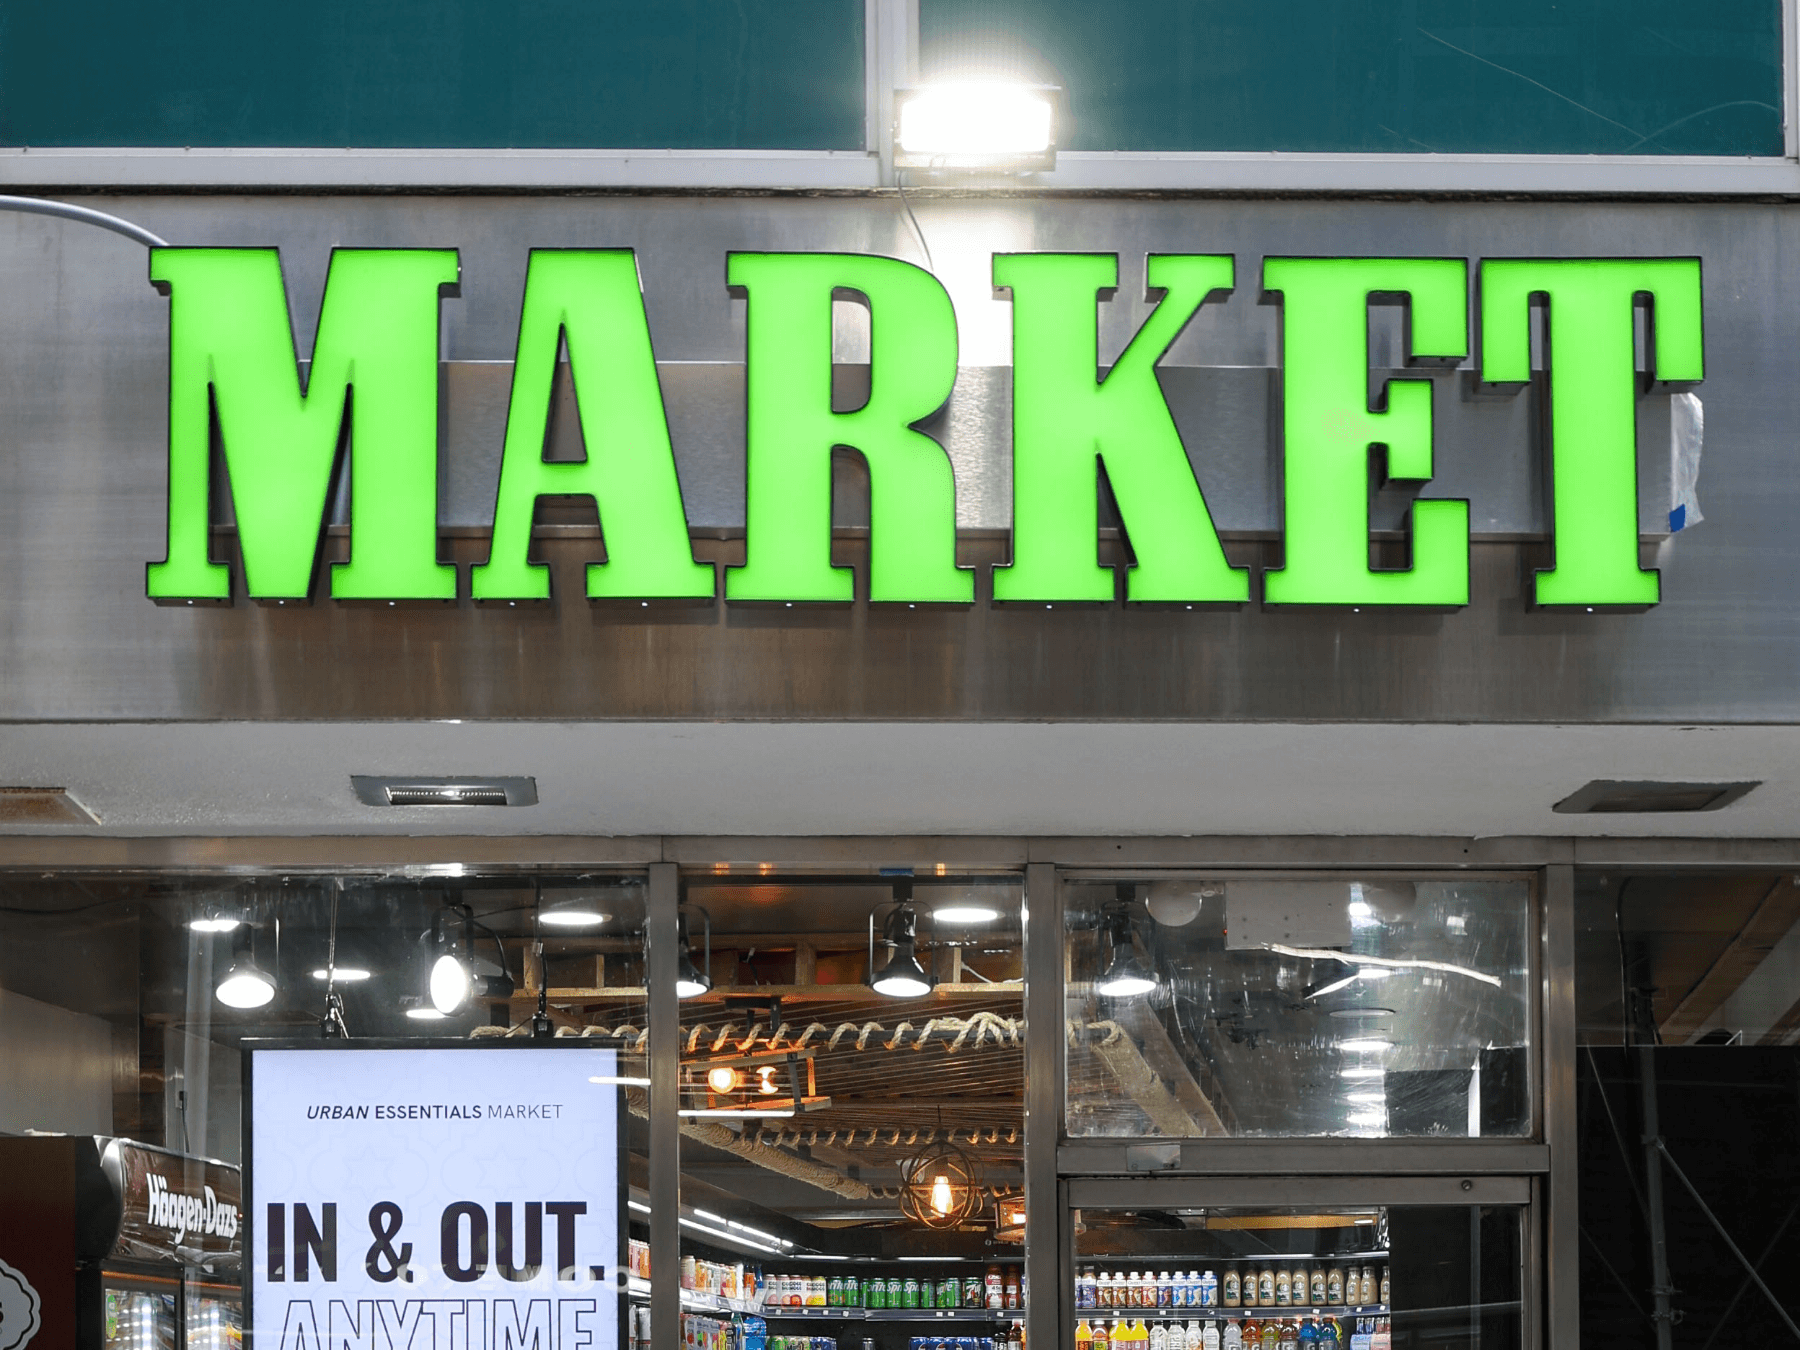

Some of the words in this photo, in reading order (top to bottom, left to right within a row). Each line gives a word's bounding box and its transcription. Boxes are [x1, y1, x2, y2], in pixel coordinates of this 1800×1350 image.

[146, 247, 1704, 608] MARKET
[307, 1105, 369, 1119] URBAN
[375, 1105, 482, 1119] ESSENTIALS
[488, 1104, 563, 1119] MARKET
[146, 1172, 238, 1244] Häagen-Dazs
[267, 1202, 337, 1282] IN
[365, 1201, 413, 1283] &
[440, 1201, 605, 1282] OUT.
